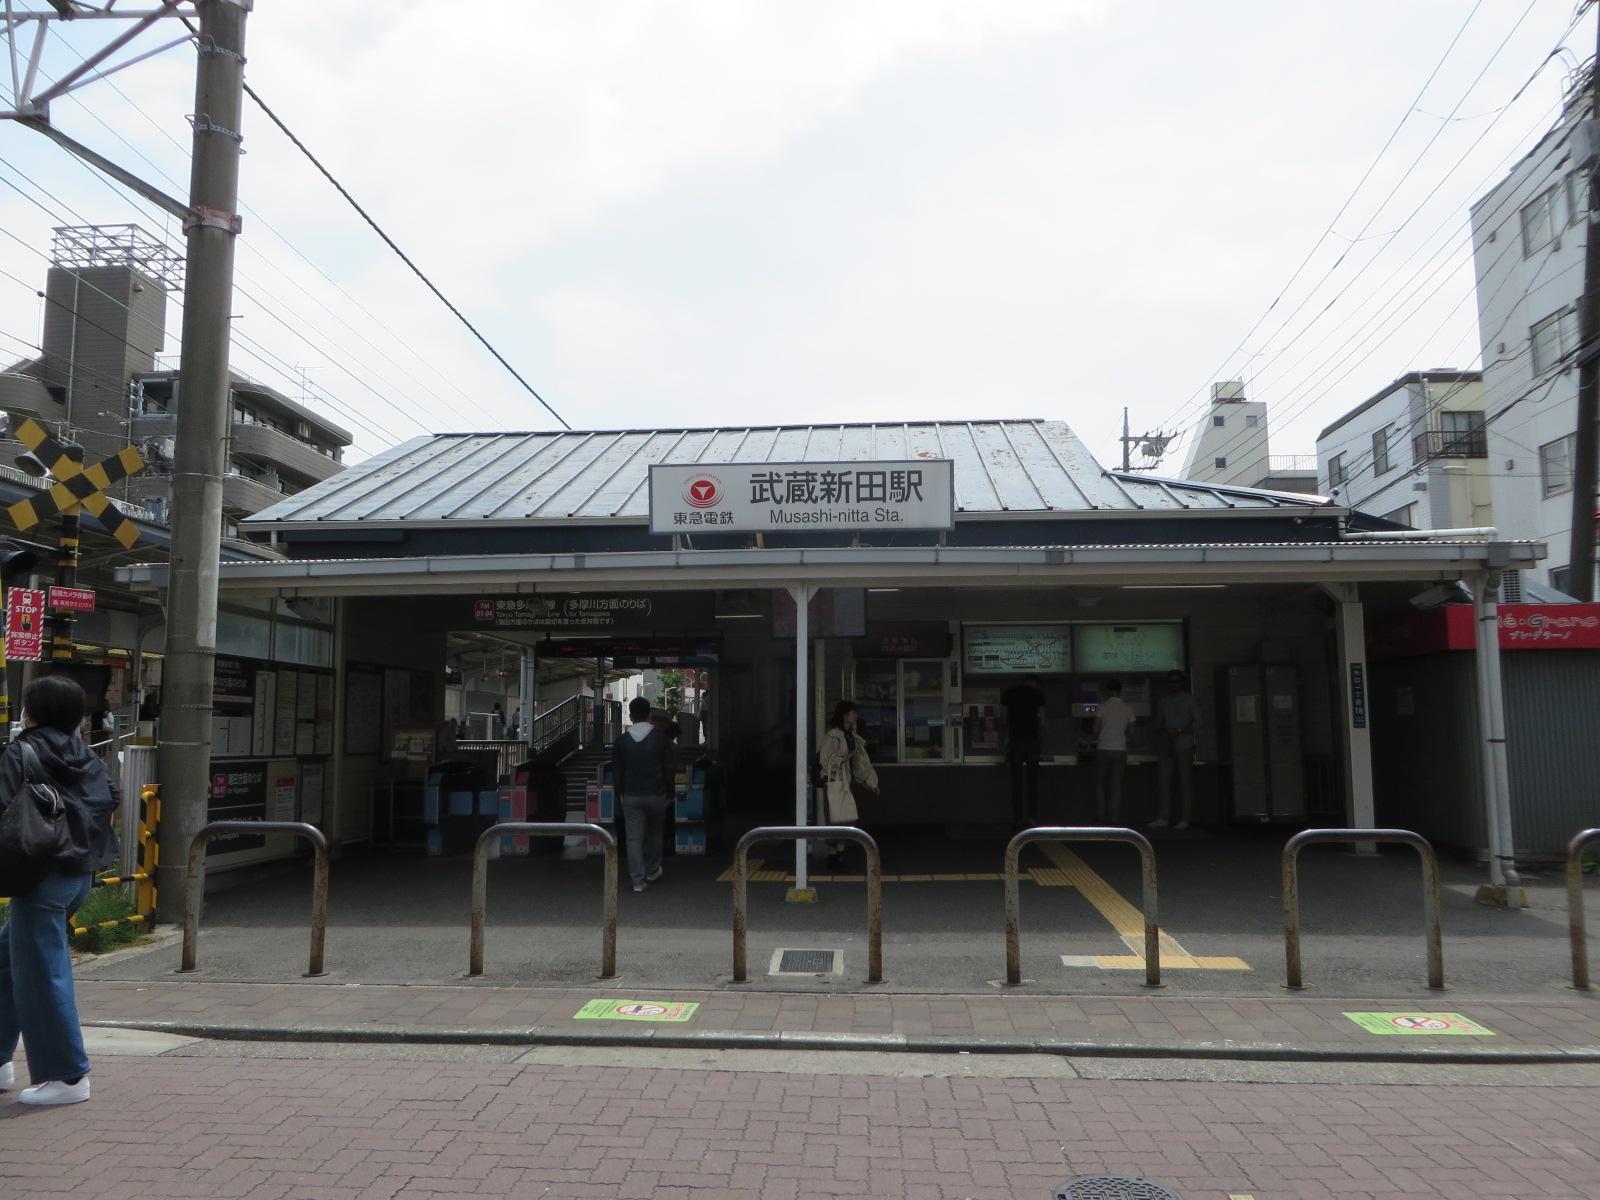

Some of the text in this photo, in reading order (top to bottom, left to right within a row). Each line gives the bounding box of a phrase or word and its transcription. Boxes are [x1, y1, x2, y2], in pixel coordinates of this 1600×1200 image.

[750, 470, 924, 505] 武蔵新田駅
[673, 511, 734, 525] 東急電鉄
[770, 508, 904, 524] Musashi-nitta Sta.
[16, 605, 37, 613] STOP
